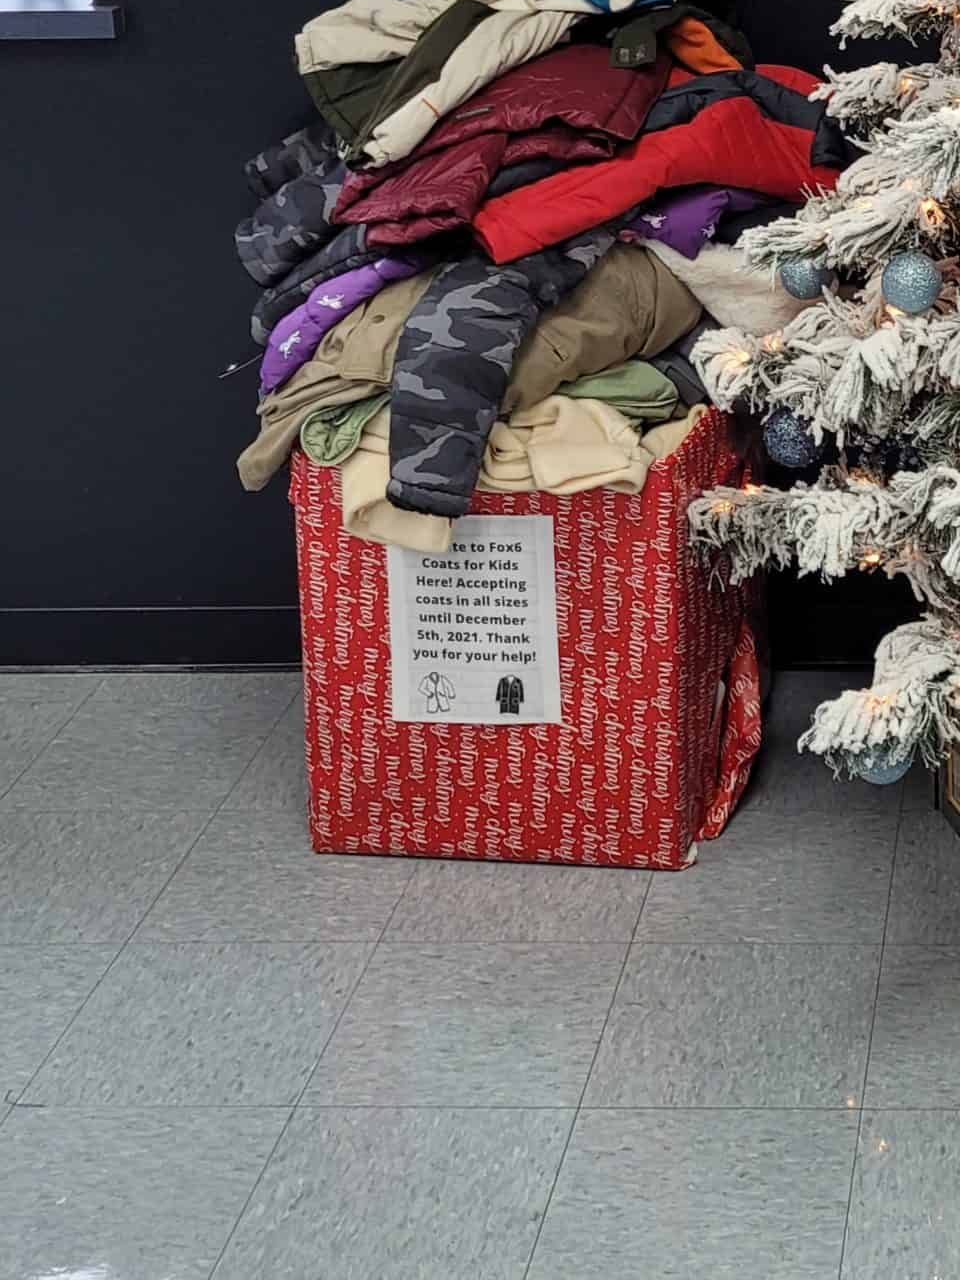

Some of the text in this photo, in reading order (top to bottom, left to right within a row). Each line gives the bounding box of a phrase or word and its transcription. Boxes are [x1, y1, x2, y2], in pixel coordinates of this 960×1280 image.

[470, 542, 485, 553] to
[489, 541, 522, 553] Fox6
[422, 558, 519, 571] Coats for Kids
[416, 575, 527, 593] Here! Accepting
[415, 595, 529, 608] coats in all sizes
[418, 612, 527, 626] until December
[416, 629, 531, 644] 5th, 2021. Thank
[412, 648, 537, 664] you for your help!
